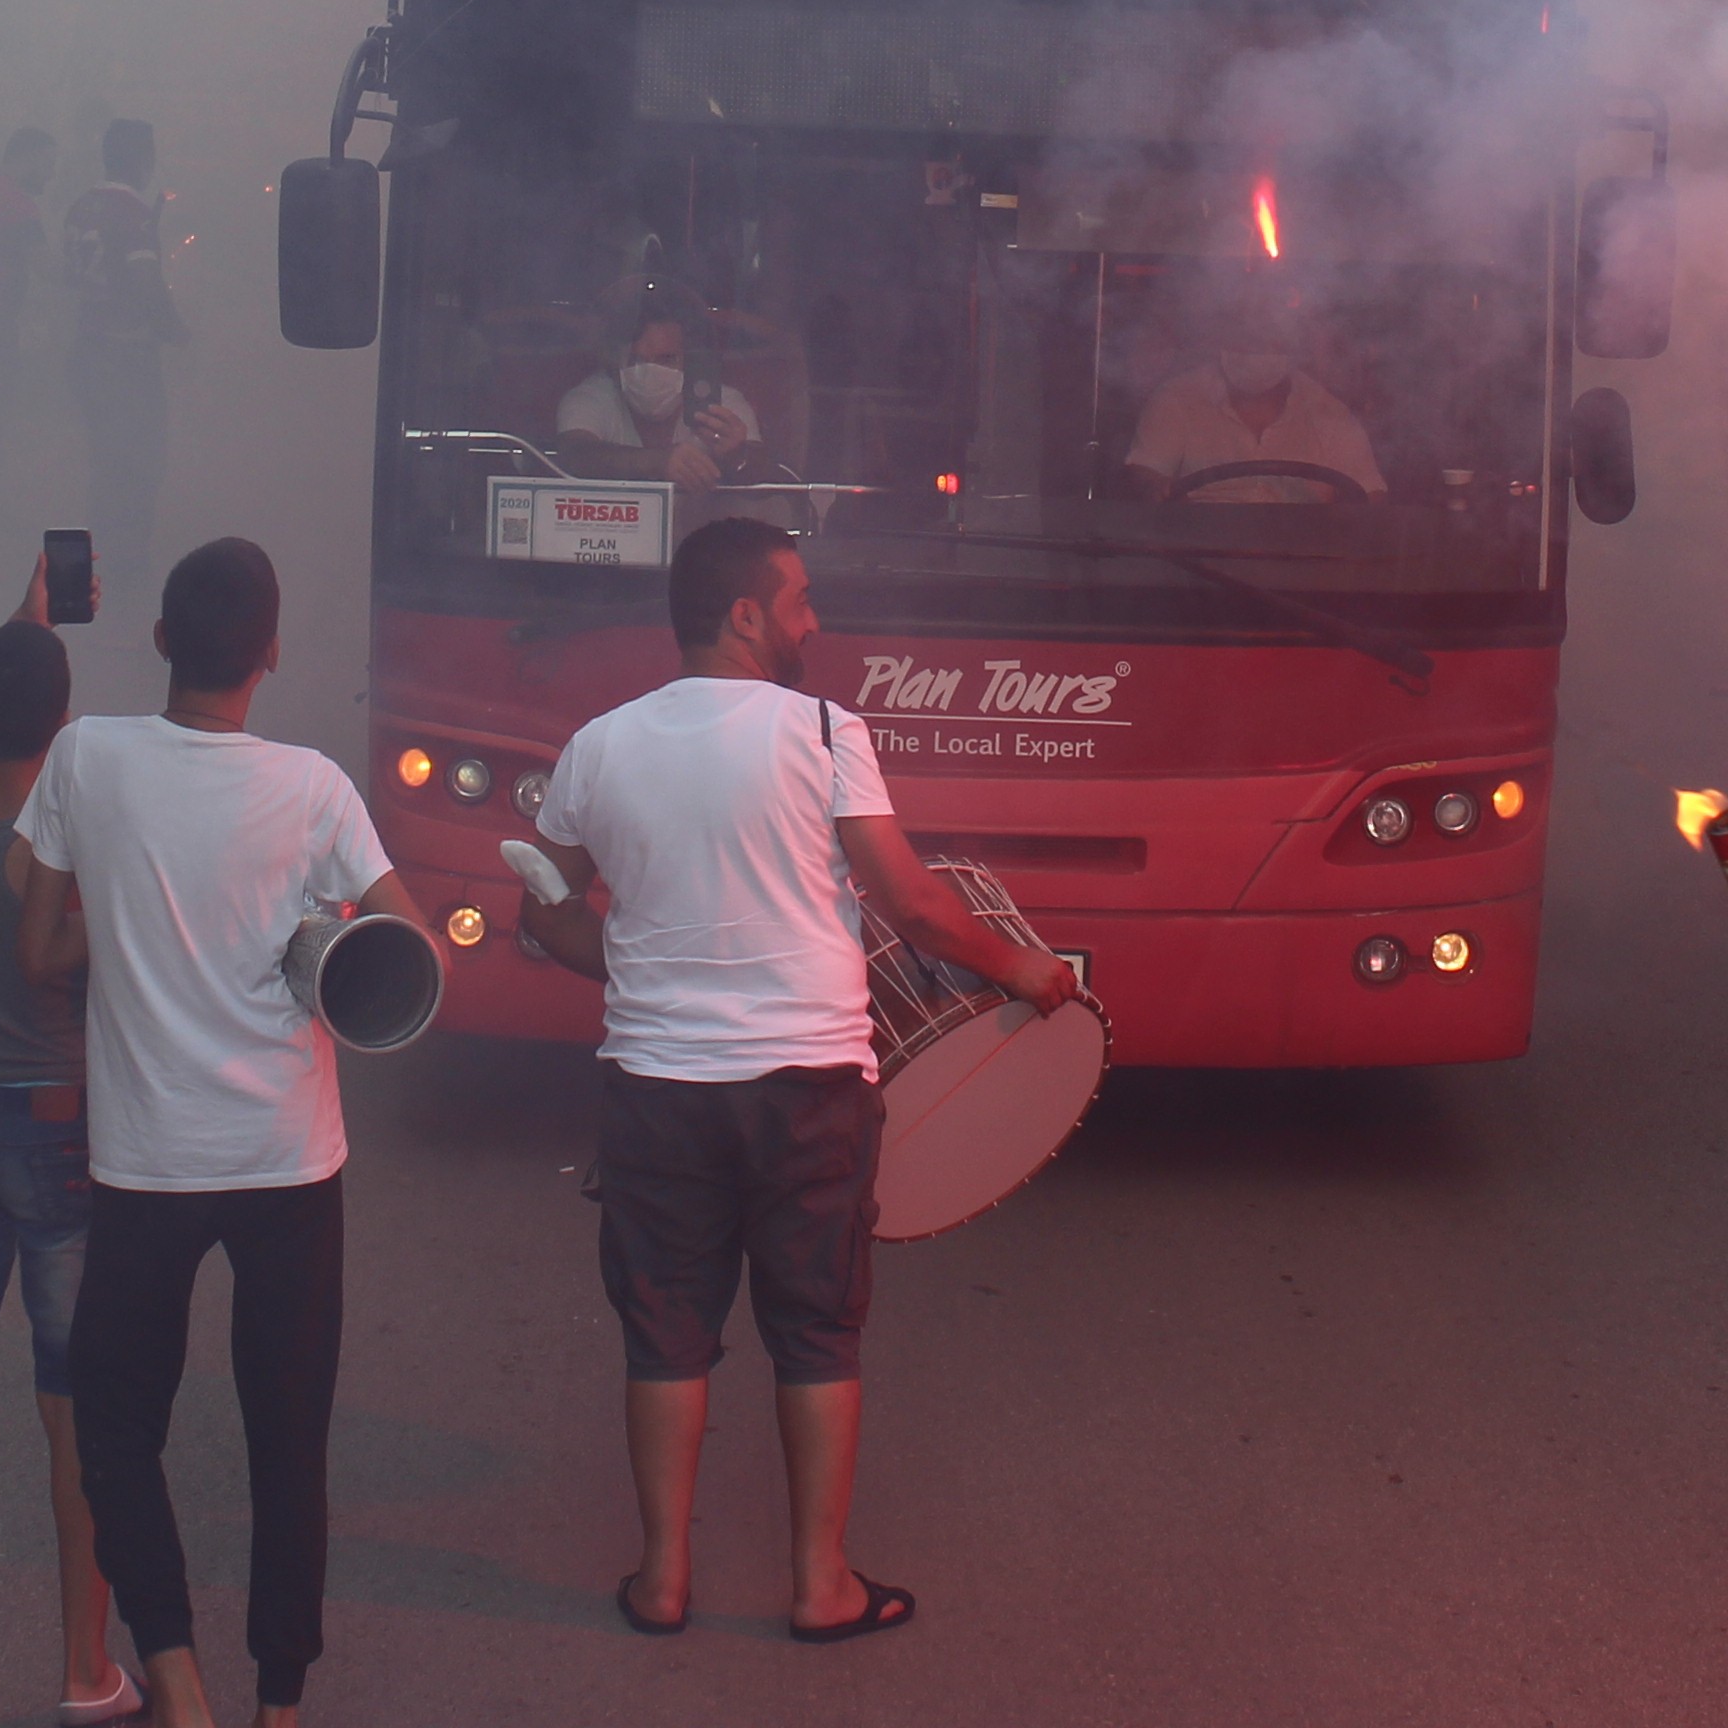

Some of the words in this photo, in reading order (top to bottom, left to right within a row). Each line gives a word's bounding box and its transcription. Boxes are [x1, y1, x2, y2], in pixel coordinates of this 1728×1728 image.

[499, 496, 531, 510] 2020
[554, 496, 640, 523] TÜRSAB
[579, 537, 616, 551] PLAN
[574, 551, 621, 565] TOURS
[854, 654, 964, 713] Plan
[977, 659, 1118, 715] Tours
[872, 727, 920, 754] The
[933, 730, 1002, 757] Local
[1015, 732, 1096, 764] Expert
